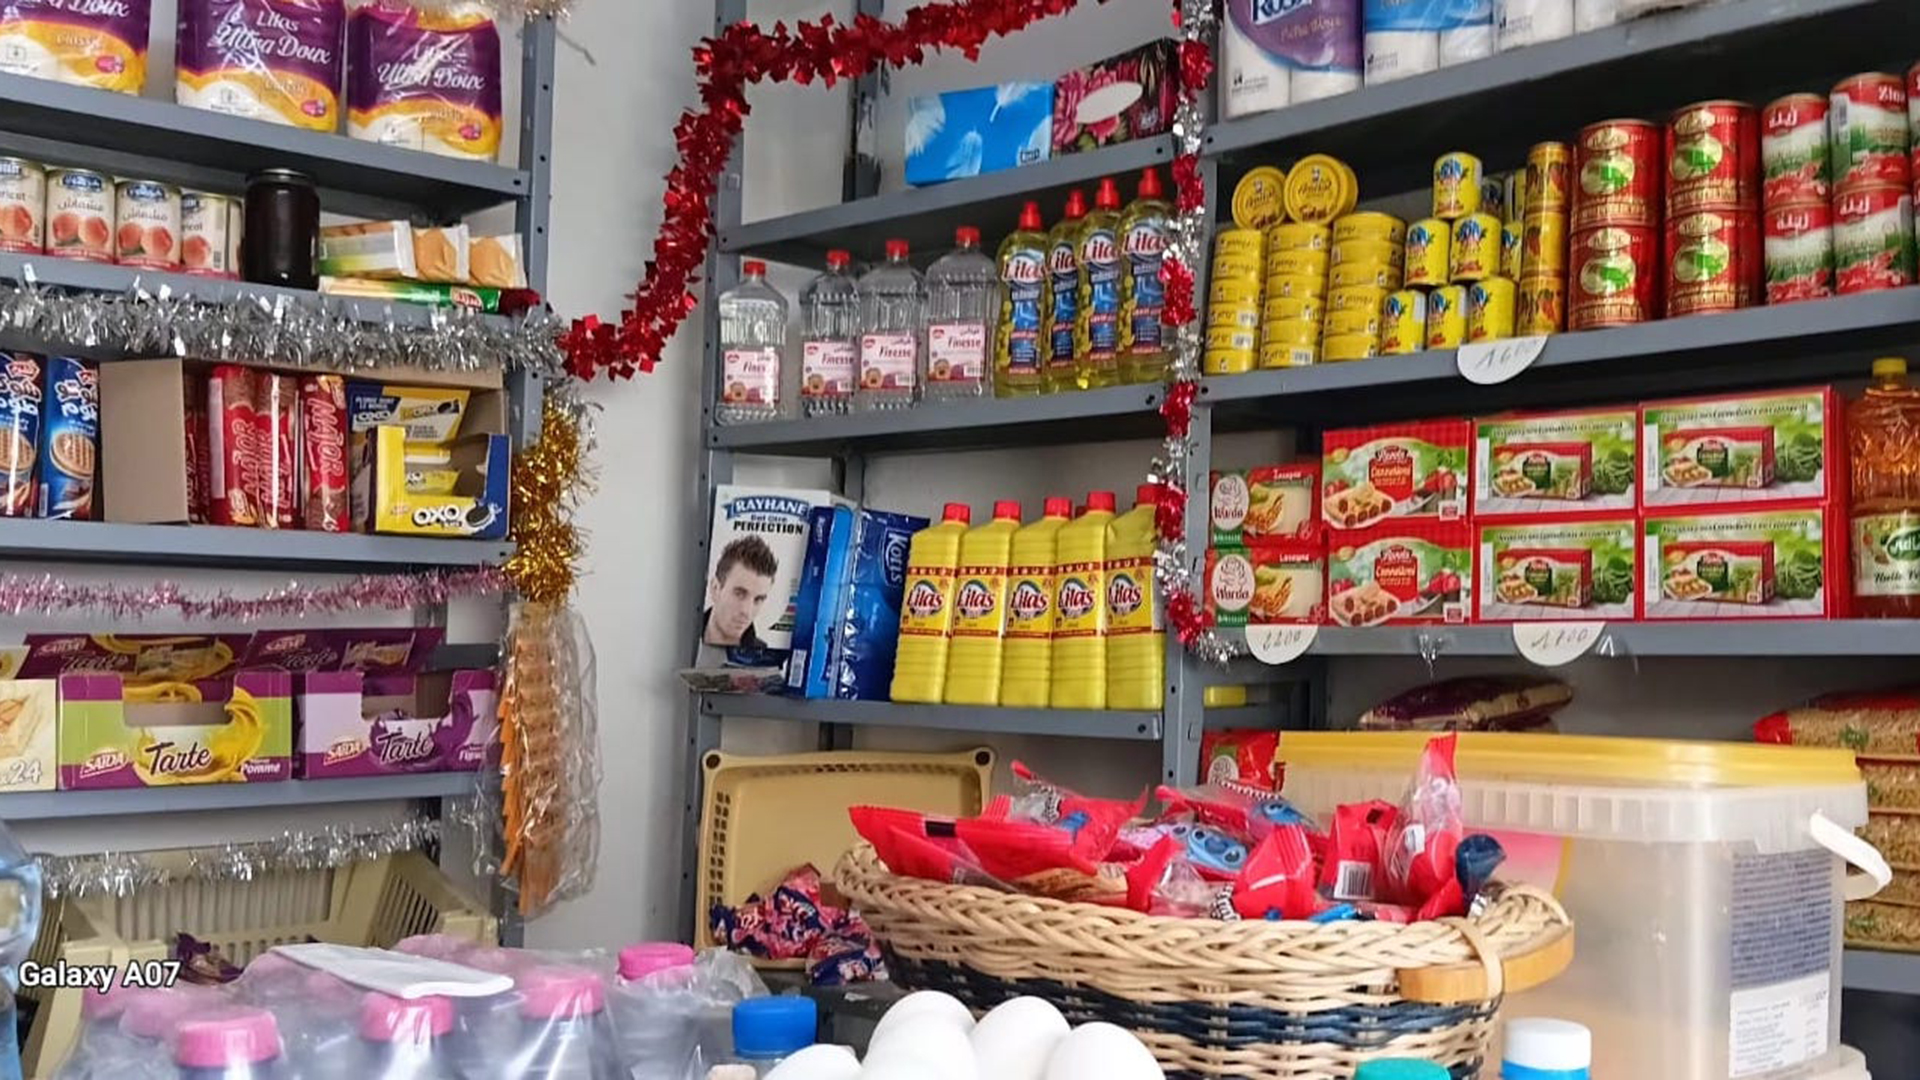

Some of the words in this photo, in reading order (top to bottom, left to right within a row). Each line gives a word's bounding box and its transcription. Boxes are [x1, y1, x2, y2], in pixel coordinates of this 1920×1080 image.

[278, 35, 332, 65] Doux
[433, 67, 485, 90] Doux
[1051, 250, 1077, 274] Lila
[1081, 238, 1119, 264] Lila
[1002, 261, 1047, 281] Lilas
[879, 345, 911, 358] Finesse
[948, 337, 981, 348] Finesse
[308, 397, 346, 479] MAJOR
[231, 418, 259, 495] MAJOR
[412, 503, 460, 527] OXO
[735, 498, 807, 517] RAYHANE
[1214, 506, 1244, 520] Warda
[733, 520, 804, 536] PERFECTION
[1891, 532, 1920, 554] Adl
[907, 588, 943, 606] Lilas
[957, 587, 994, 608] Lilas
[1010, 588, 1048, 608] Lilas
[1058, 586, 1095, 608] Lilas
[1108, 582, 1142, 605] Lilas
[1216, 586, 1249, 600] Warda
[145, 741, 211, 775] Tarte
[378, 733, 433, 762] Tarte
[241, 763, 281, 774] Pomme
